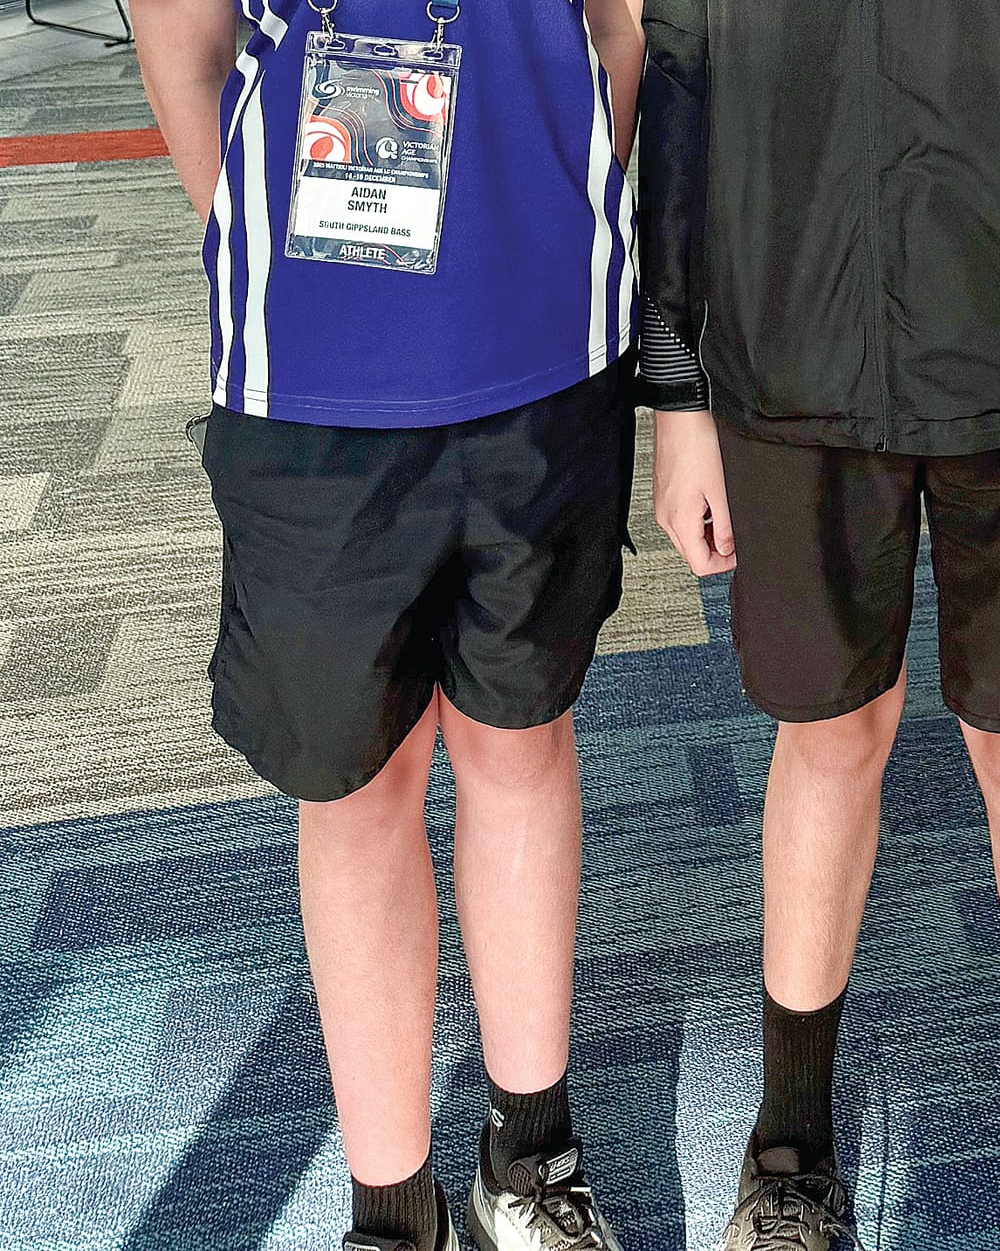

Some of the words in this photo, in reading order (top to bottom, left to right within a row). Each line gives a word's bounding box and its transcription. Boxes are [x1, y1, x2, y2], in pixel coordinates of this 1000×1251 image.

[401, 148, 417, 156] AGE
[402, 140, 440, 151] VICTORIAN
[351, 187, 387, 200] AIDAN
[347, 200, 388, 214] SMYTH
[319, 220, 345, 230] SOUTH
[345, 222, 389, 234] GIPPSLAND
[390, 227, 411, 237] BASS
[339, 244, 386, 260] ATHLETE
